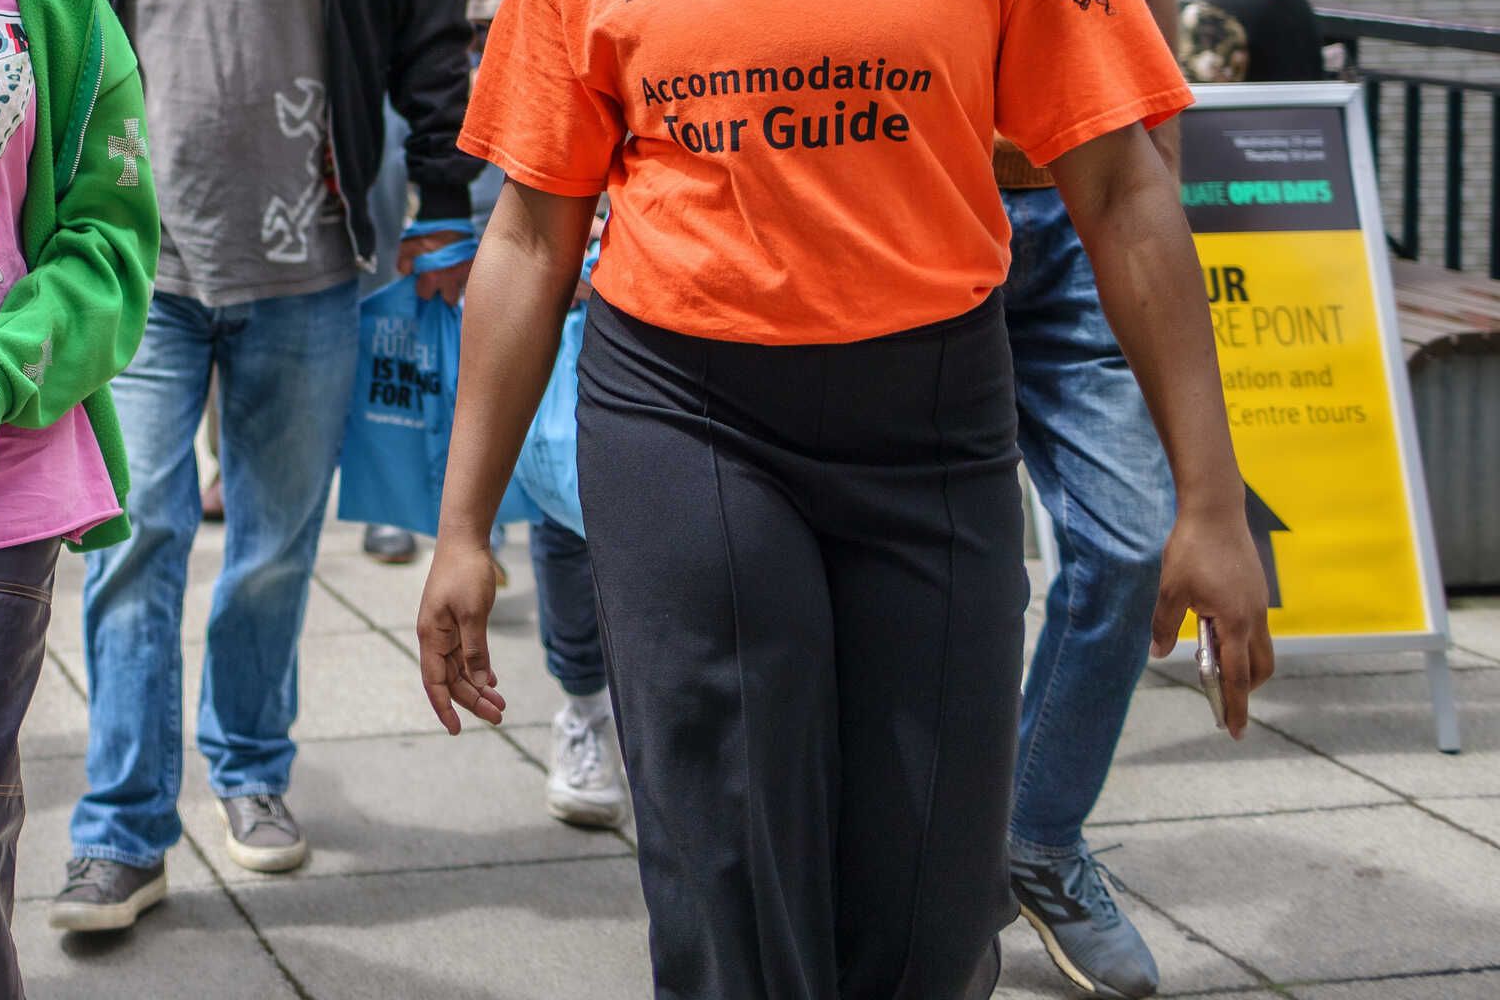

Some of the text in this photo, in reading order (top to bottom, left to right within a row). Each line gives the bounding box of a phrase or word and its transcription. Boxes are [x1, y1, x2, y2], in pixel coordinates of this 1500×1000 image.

[642, 56, 932, 106] Accommodation
[663, 101, 910, 154] Tour Guide
[1229, 180, 1282, 206] OPEN
[1283, 179, 1334, 204] DAYS
[1252, 304, 1345, 348] POINT
[373, 357, 393, 379] IS
[1223, 365, 1334, 390] ation and
[369, 382, 412, 409] FOR
[1228, 404, 1367, 426] Centre tours
